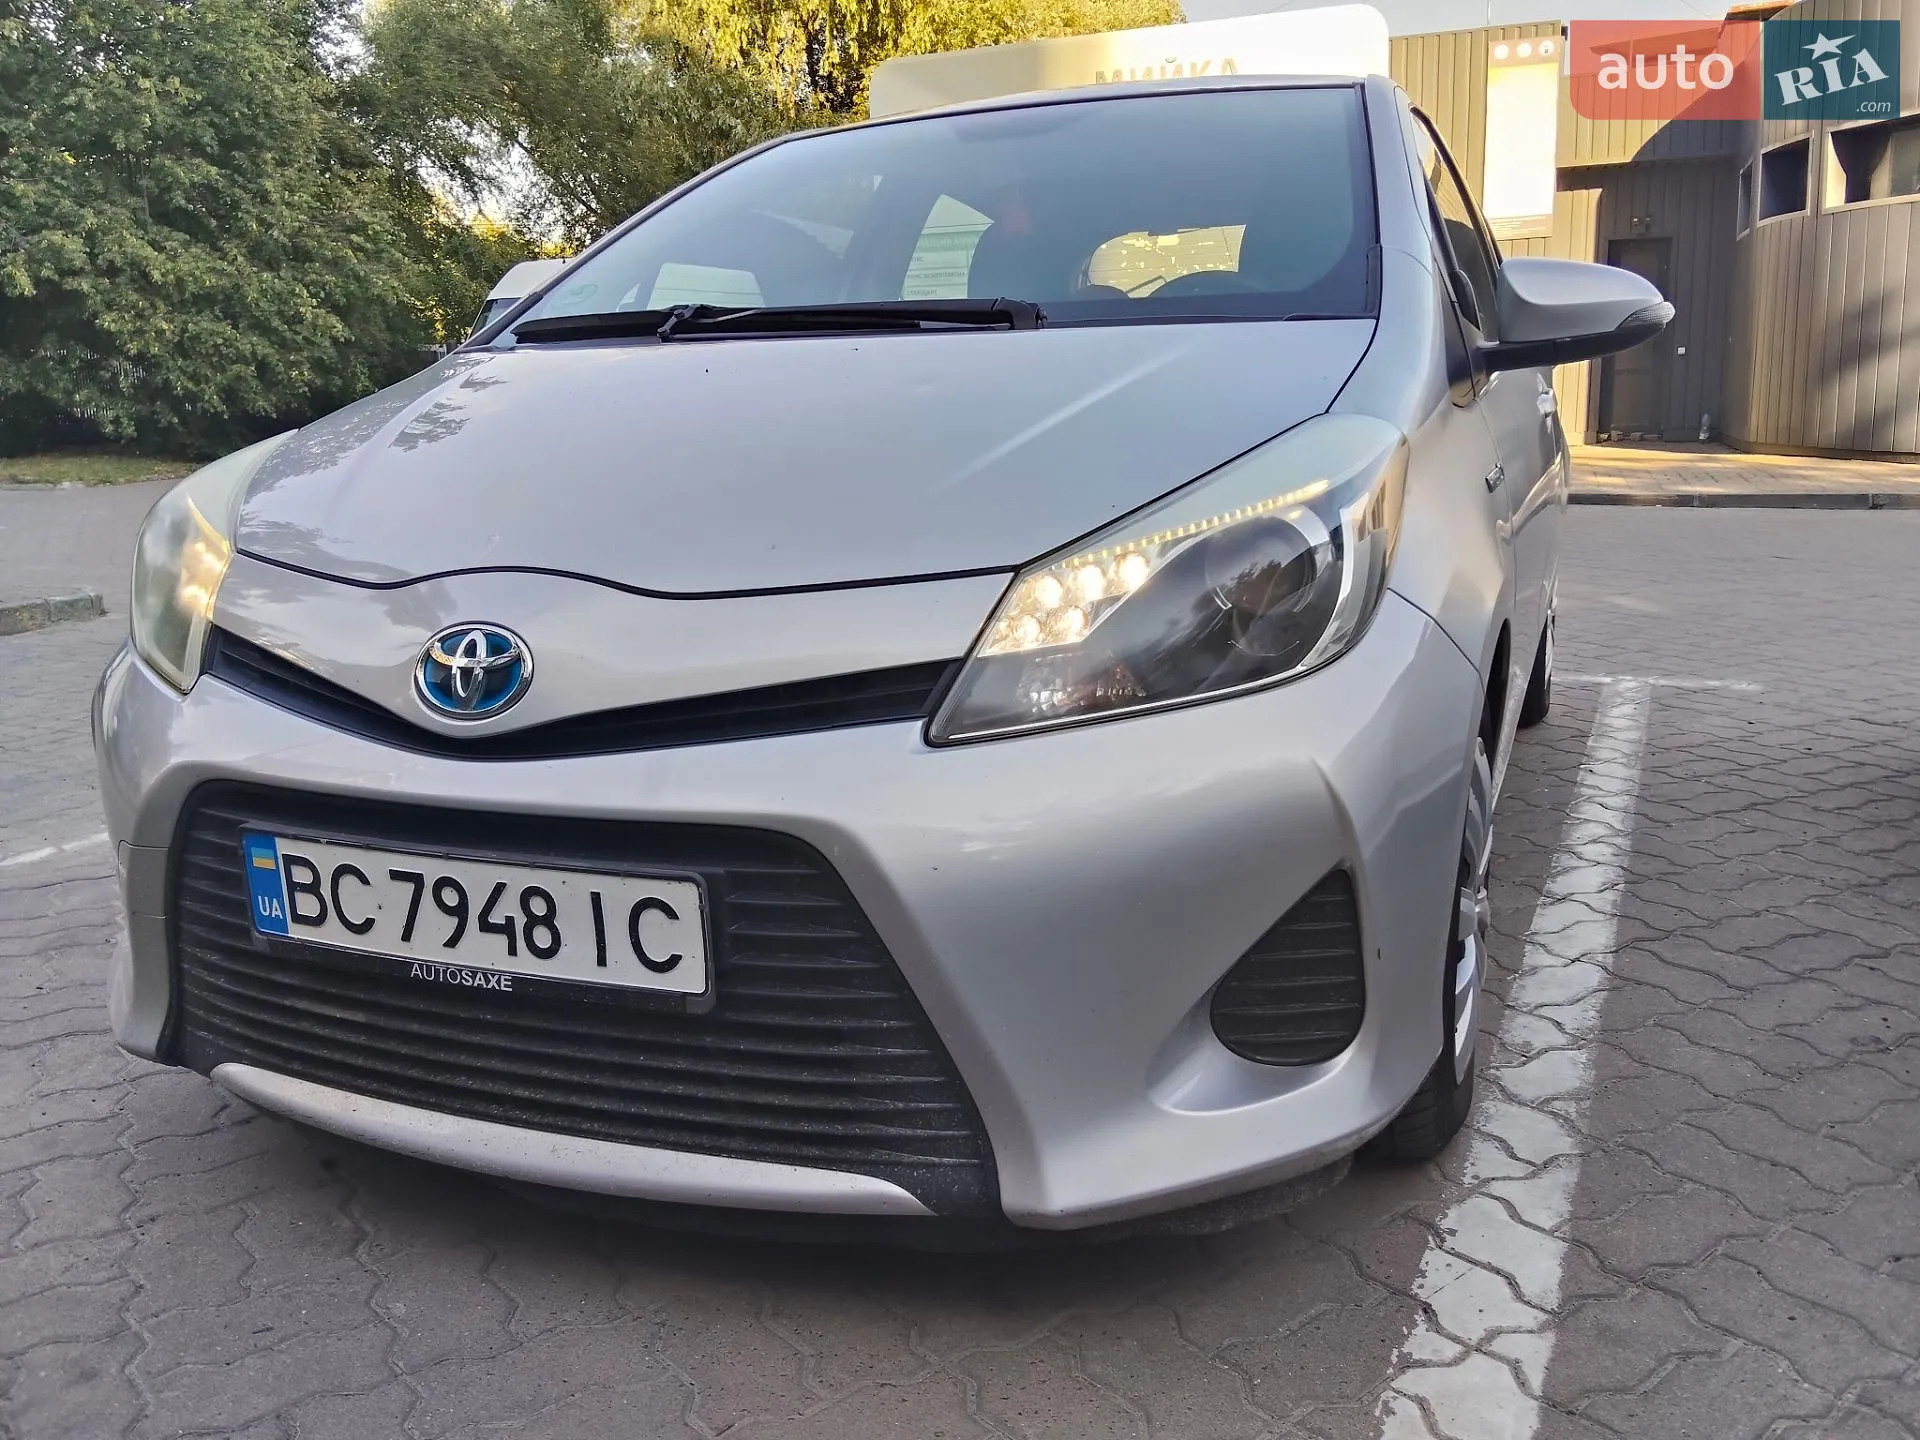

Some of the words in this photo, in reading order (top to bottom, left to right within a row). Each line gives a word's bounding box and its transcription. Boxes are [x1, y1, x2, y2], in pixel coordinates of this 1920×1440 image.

[257, 895, 284, 920] UA
[281, 853, 377, 936] BC
[388, 868, 562, 960] 7948
[589, 891, 683, 974] IC
[410, 963, 513, 992] AUTOSAXE
